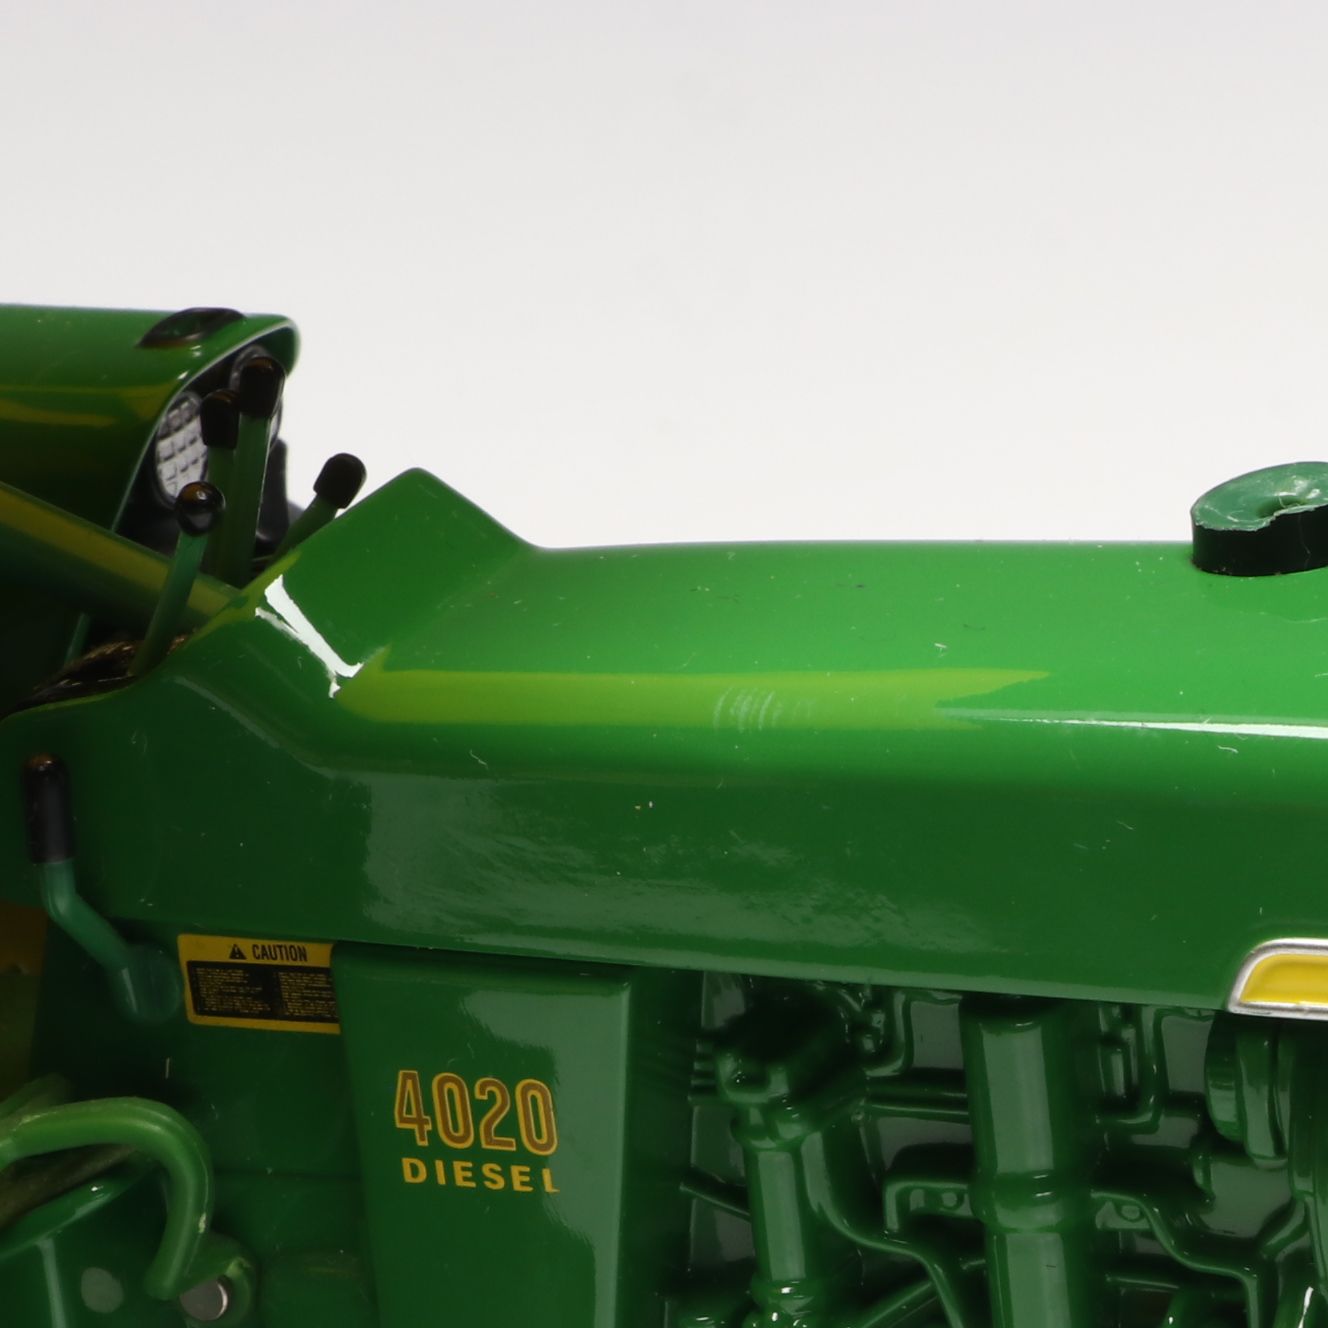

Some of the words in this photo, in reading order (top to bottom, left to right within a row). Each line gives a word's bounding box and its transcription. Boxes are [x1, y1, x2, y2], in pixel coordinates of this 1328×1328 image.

[252, 944, 308, 962] CAUTION
[394, 1070, 558, 1156] 4020
[401, 1157, 560, 1193] DIESEL
